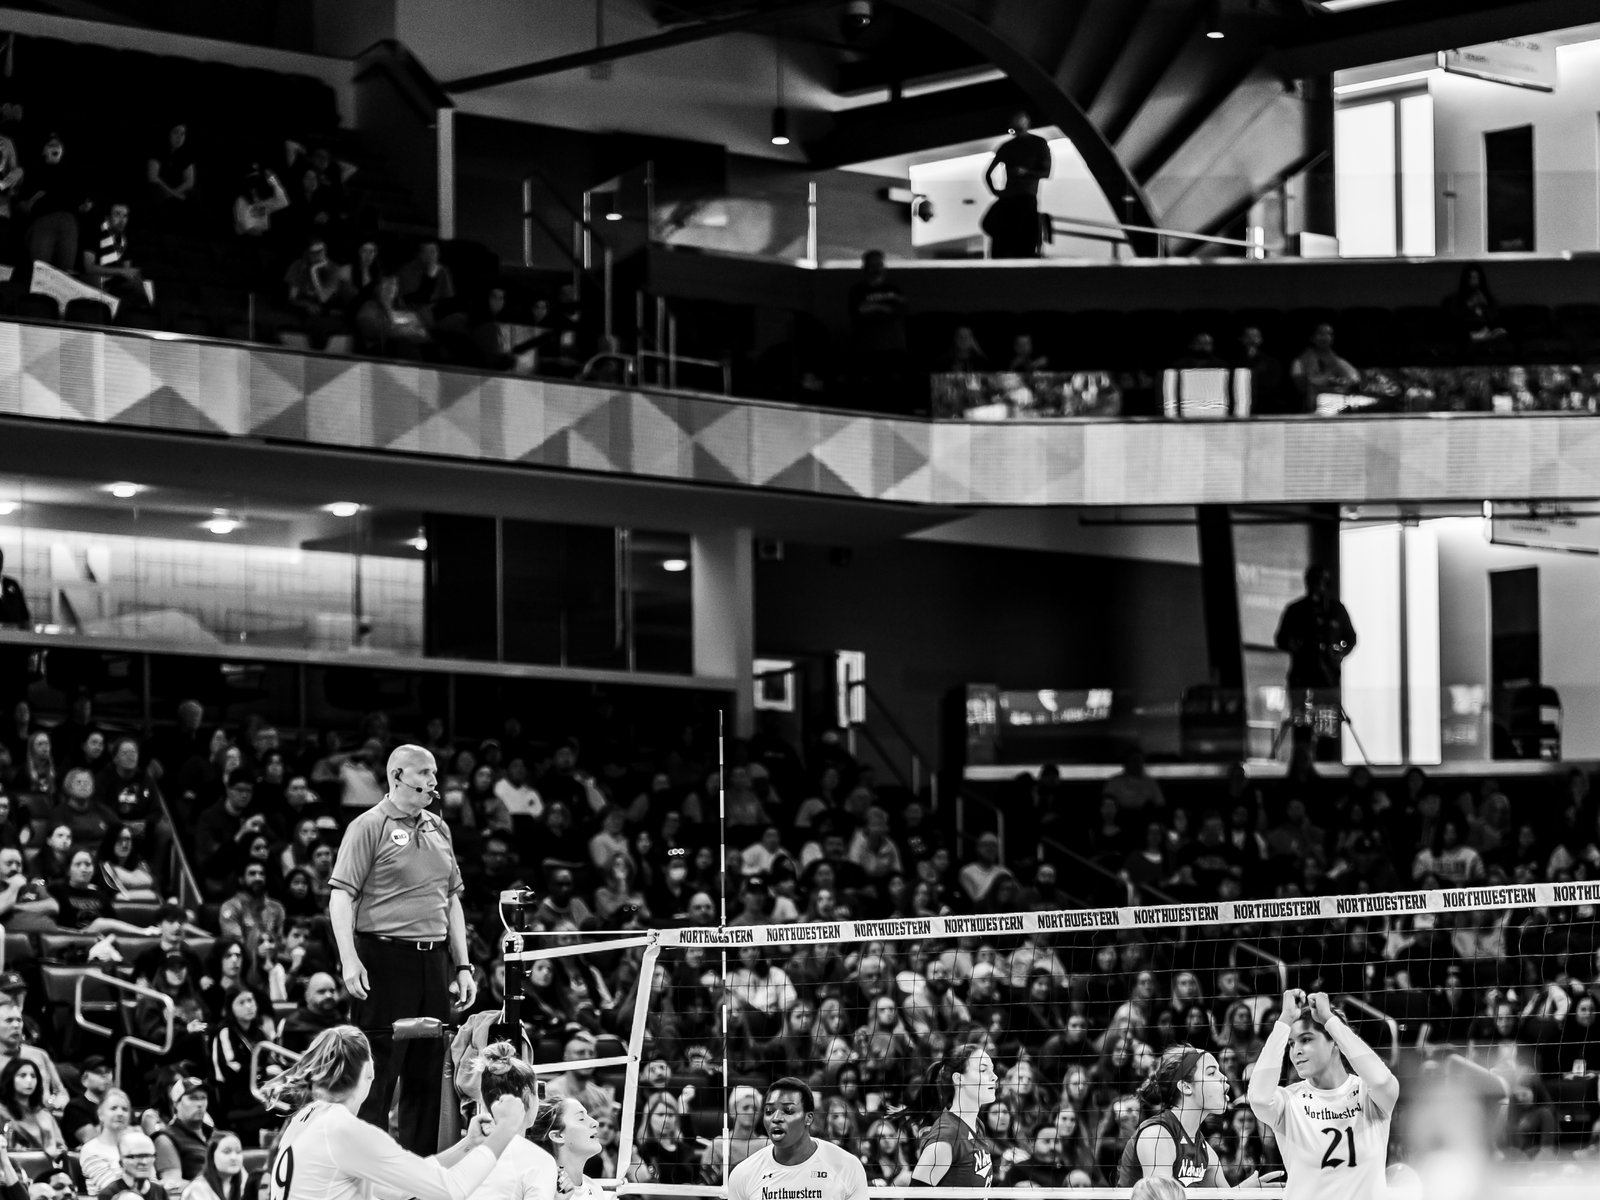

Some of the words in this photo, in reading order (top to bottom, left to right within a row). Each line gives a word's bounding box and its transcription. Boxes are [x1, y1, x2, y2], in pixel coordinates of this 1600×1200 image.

[679, 928, 753, 944] NORTHWESTERN
[766, 925, 841, 942] NORTHWESTERN
[854, 920, 931, 938] NORTHWESTERN
[944, 916, 1024, 933] NORTHWESTERN
[1037, 910, 1119, 929] NORTHWESTERN
[1133, 906, 1219, 924] NORTHWESTERN
[1233, 899, 1321, 919] NORTHWESTERN
[1336, 894, 1427, 914] NORTHWESTERN
[1442, 888, 1536, 908] NORTHWESTERN
[1321, 1126, 1357, 1169] 21
[762, 1187, 822, 1200] Northwestern
